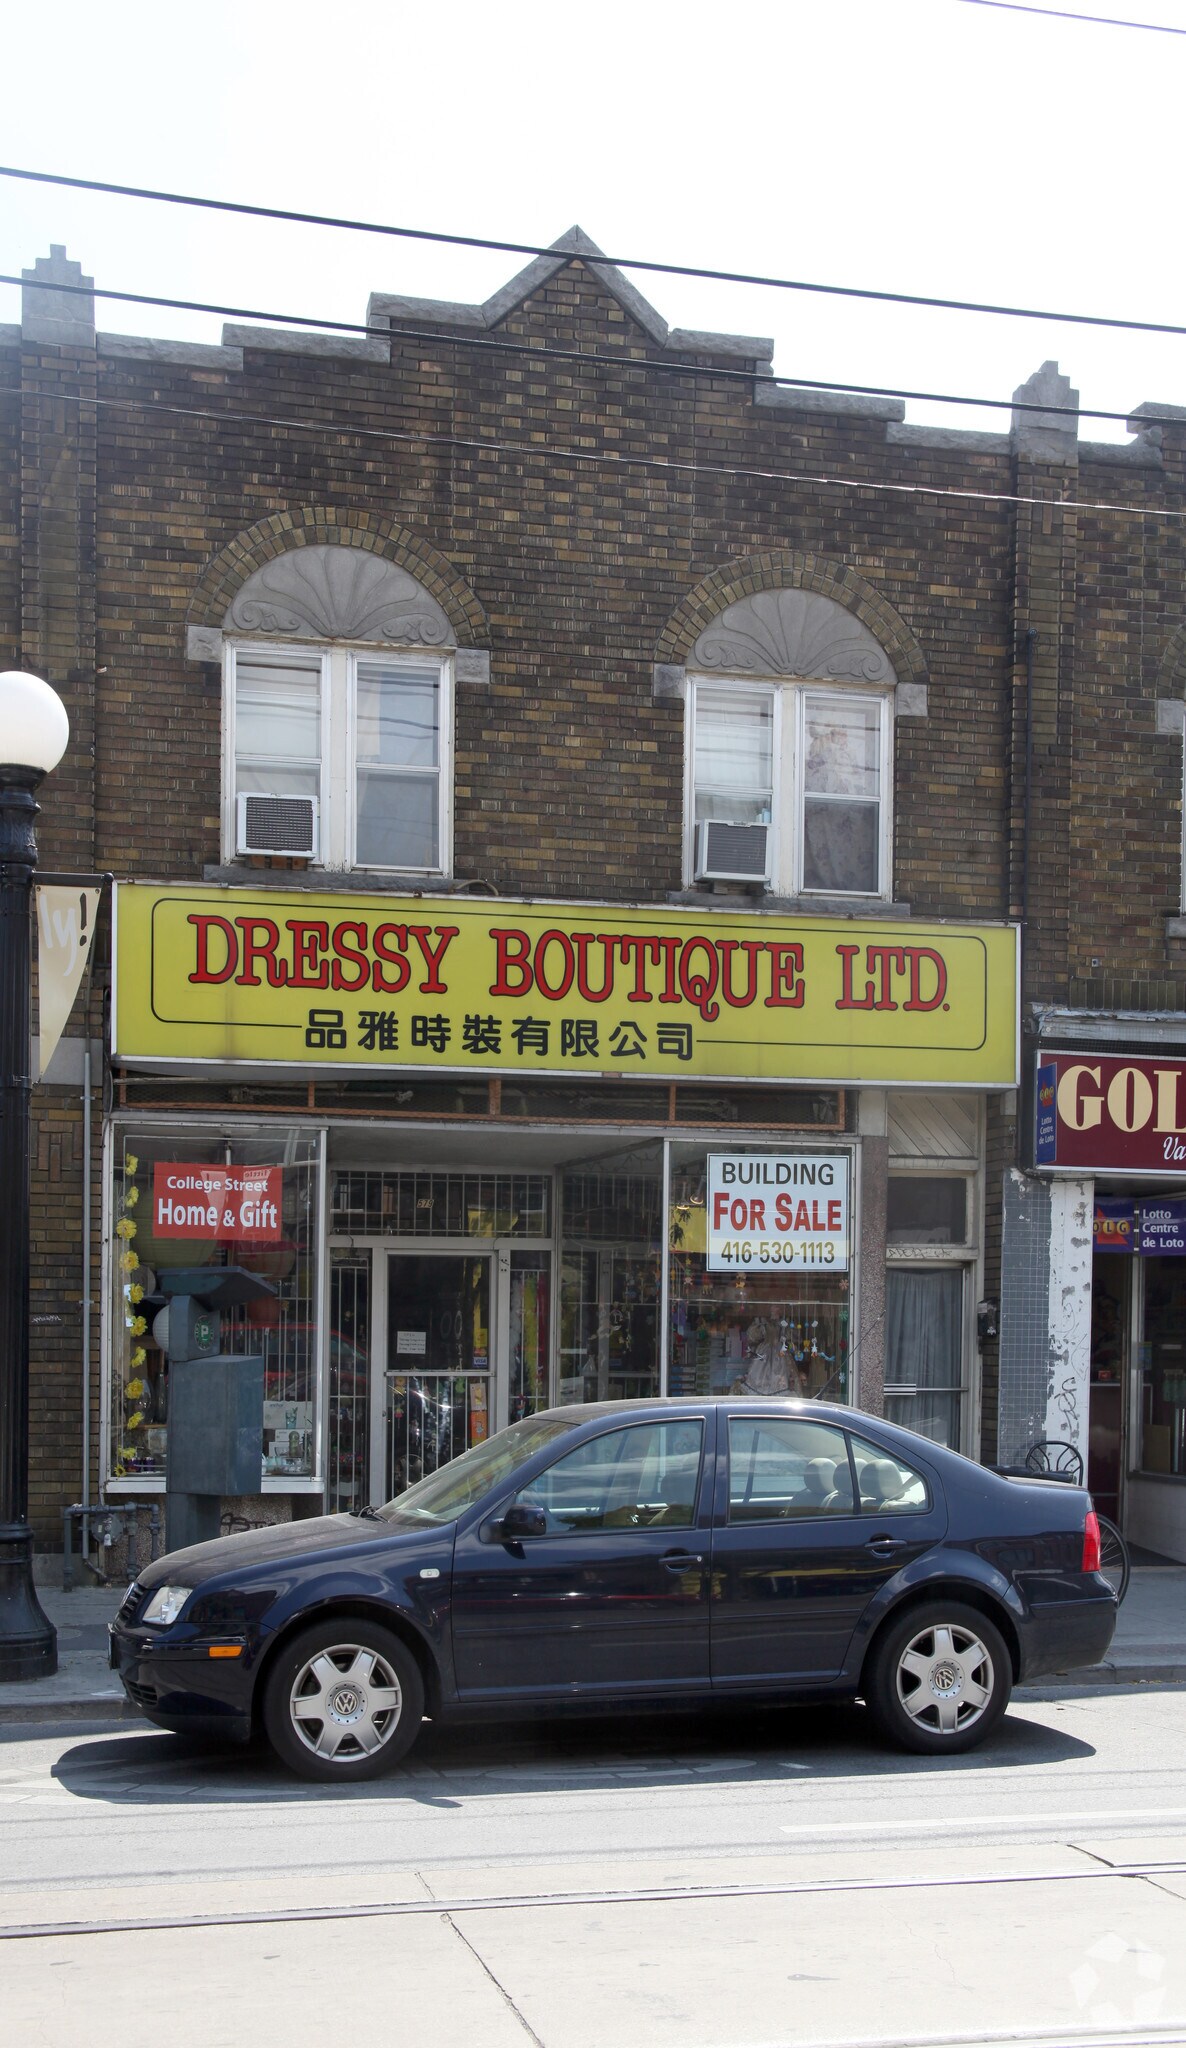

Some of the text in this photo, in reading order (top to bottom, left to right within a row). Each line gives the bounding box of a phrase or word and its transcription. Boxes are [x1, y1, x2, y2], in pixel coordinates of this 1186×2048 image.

[187, 914, 951, 1022] DRESSY BOUTIQUE LTD.
[305, 1009, 693, 1061] 品雅時裝有限公司
[1058, 1065, 1186, 1133] GOL
[1163, 1136, 1186, 1160] Va
[167, 1175, 268, 1194] College Street
[722, 1162, 834, 1186] BUILDING
[158, 1198, 278, 1228] Home & Gift
[417, 1199, 433, 1208] 579
[713, 1192, 842, 1232] FOR SALE
[1143, 1209, 1172, 1219] Lotto
[1093, 1221, 1127, 1233] OLG
[1142, 1222, 1179, 1233] Centre
[721, 1241, 835, 1264] 416-530-1113
[1142, 1237, 1185, 1248] de Loto
